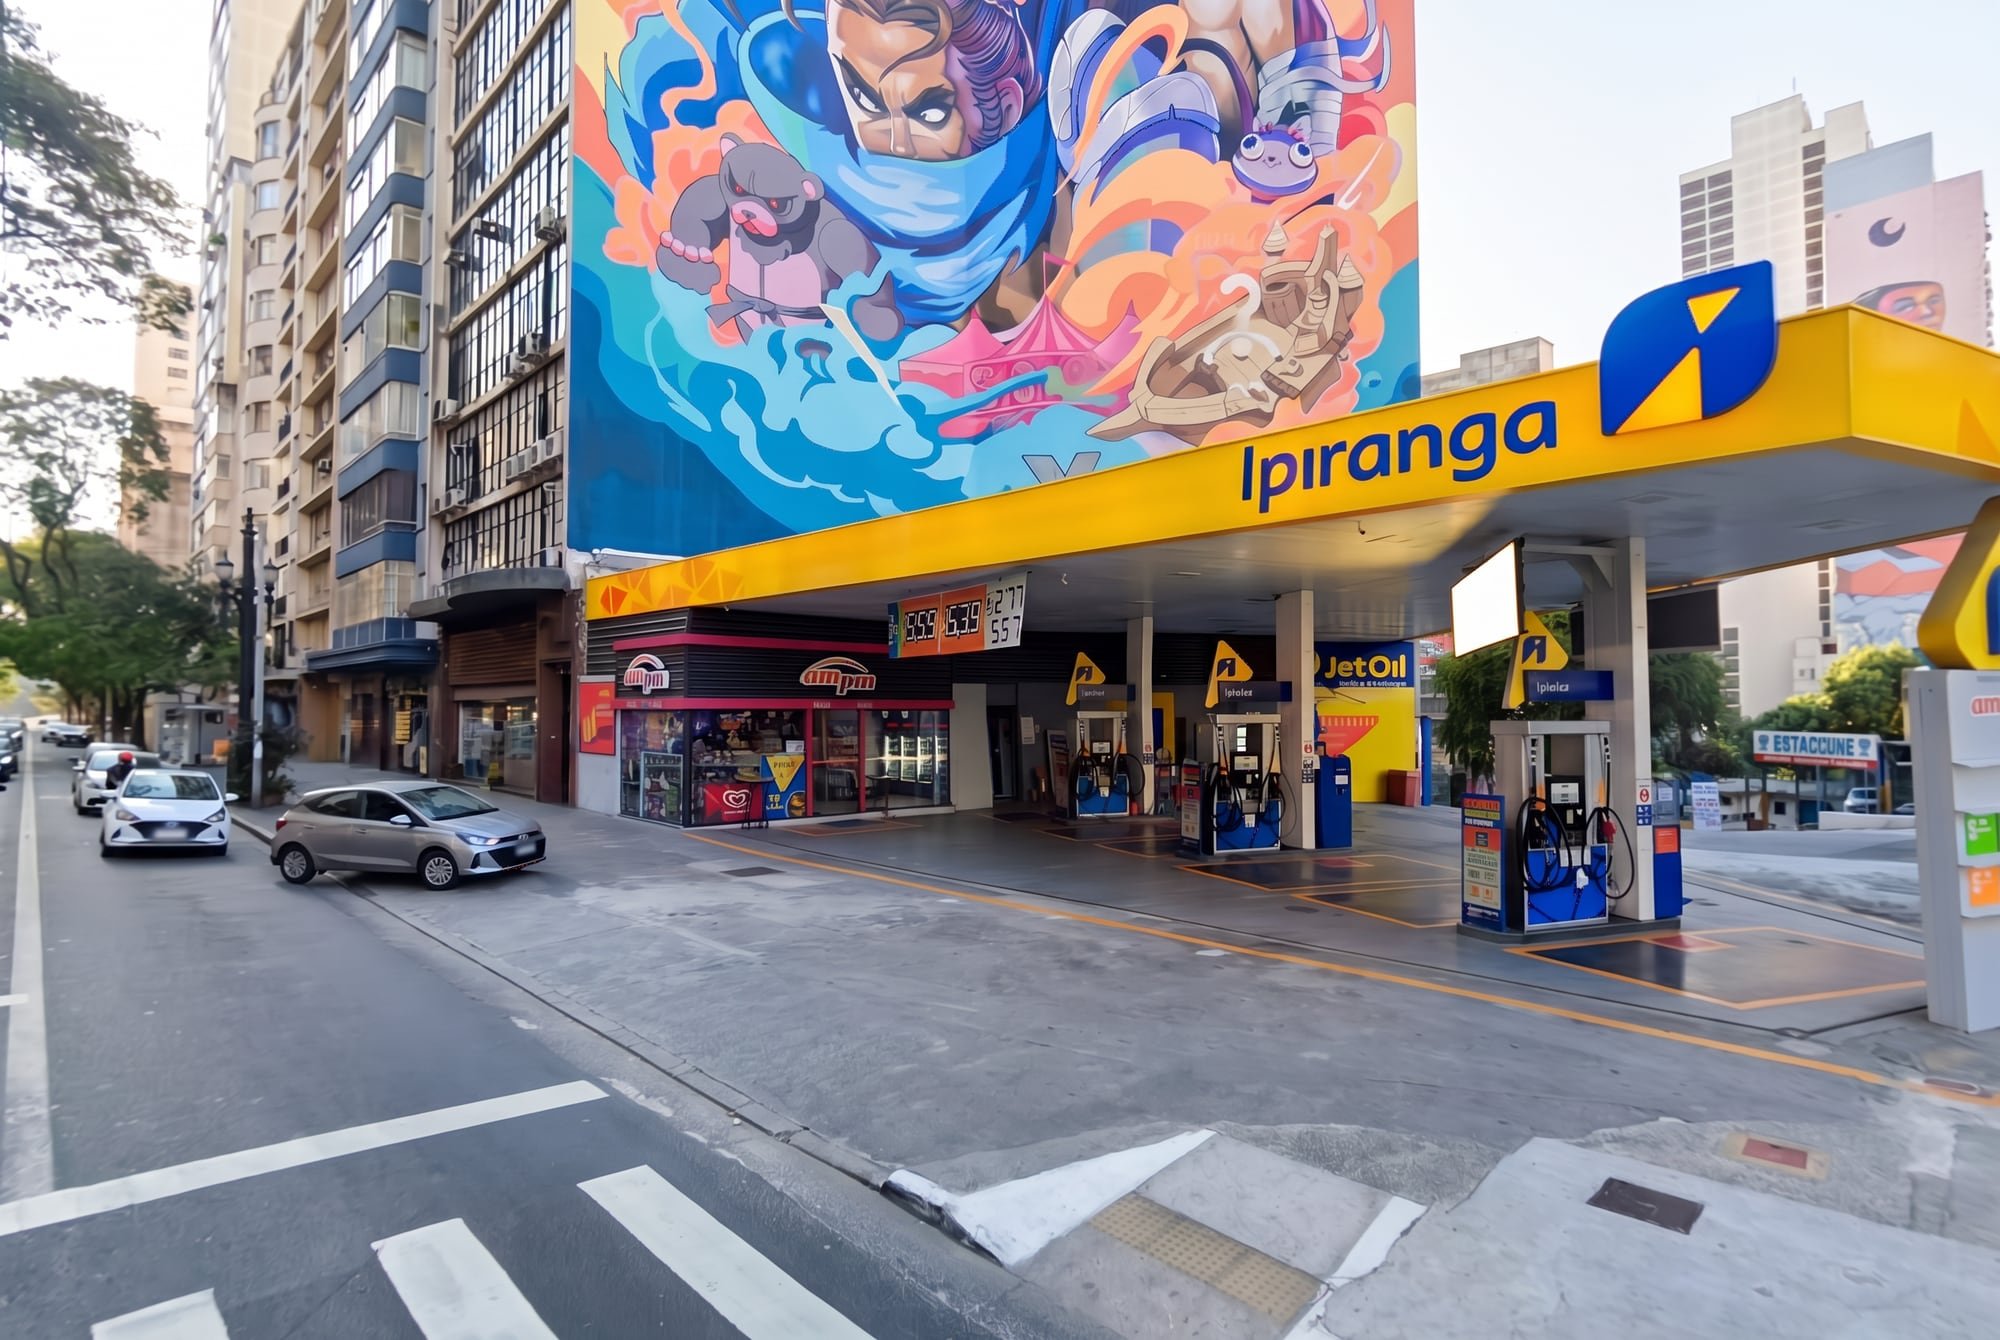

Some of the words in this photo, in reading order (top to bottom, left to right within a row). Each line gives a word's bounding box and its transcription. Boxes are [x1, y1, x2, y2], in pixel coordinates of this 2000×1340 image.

[1242, 400, 1558, 514] Ipiranga
[624, 667, 668, 694] ampm
[1324, 654, 1406, 679] JetOil
[802, 667, 877, 696] ampm
